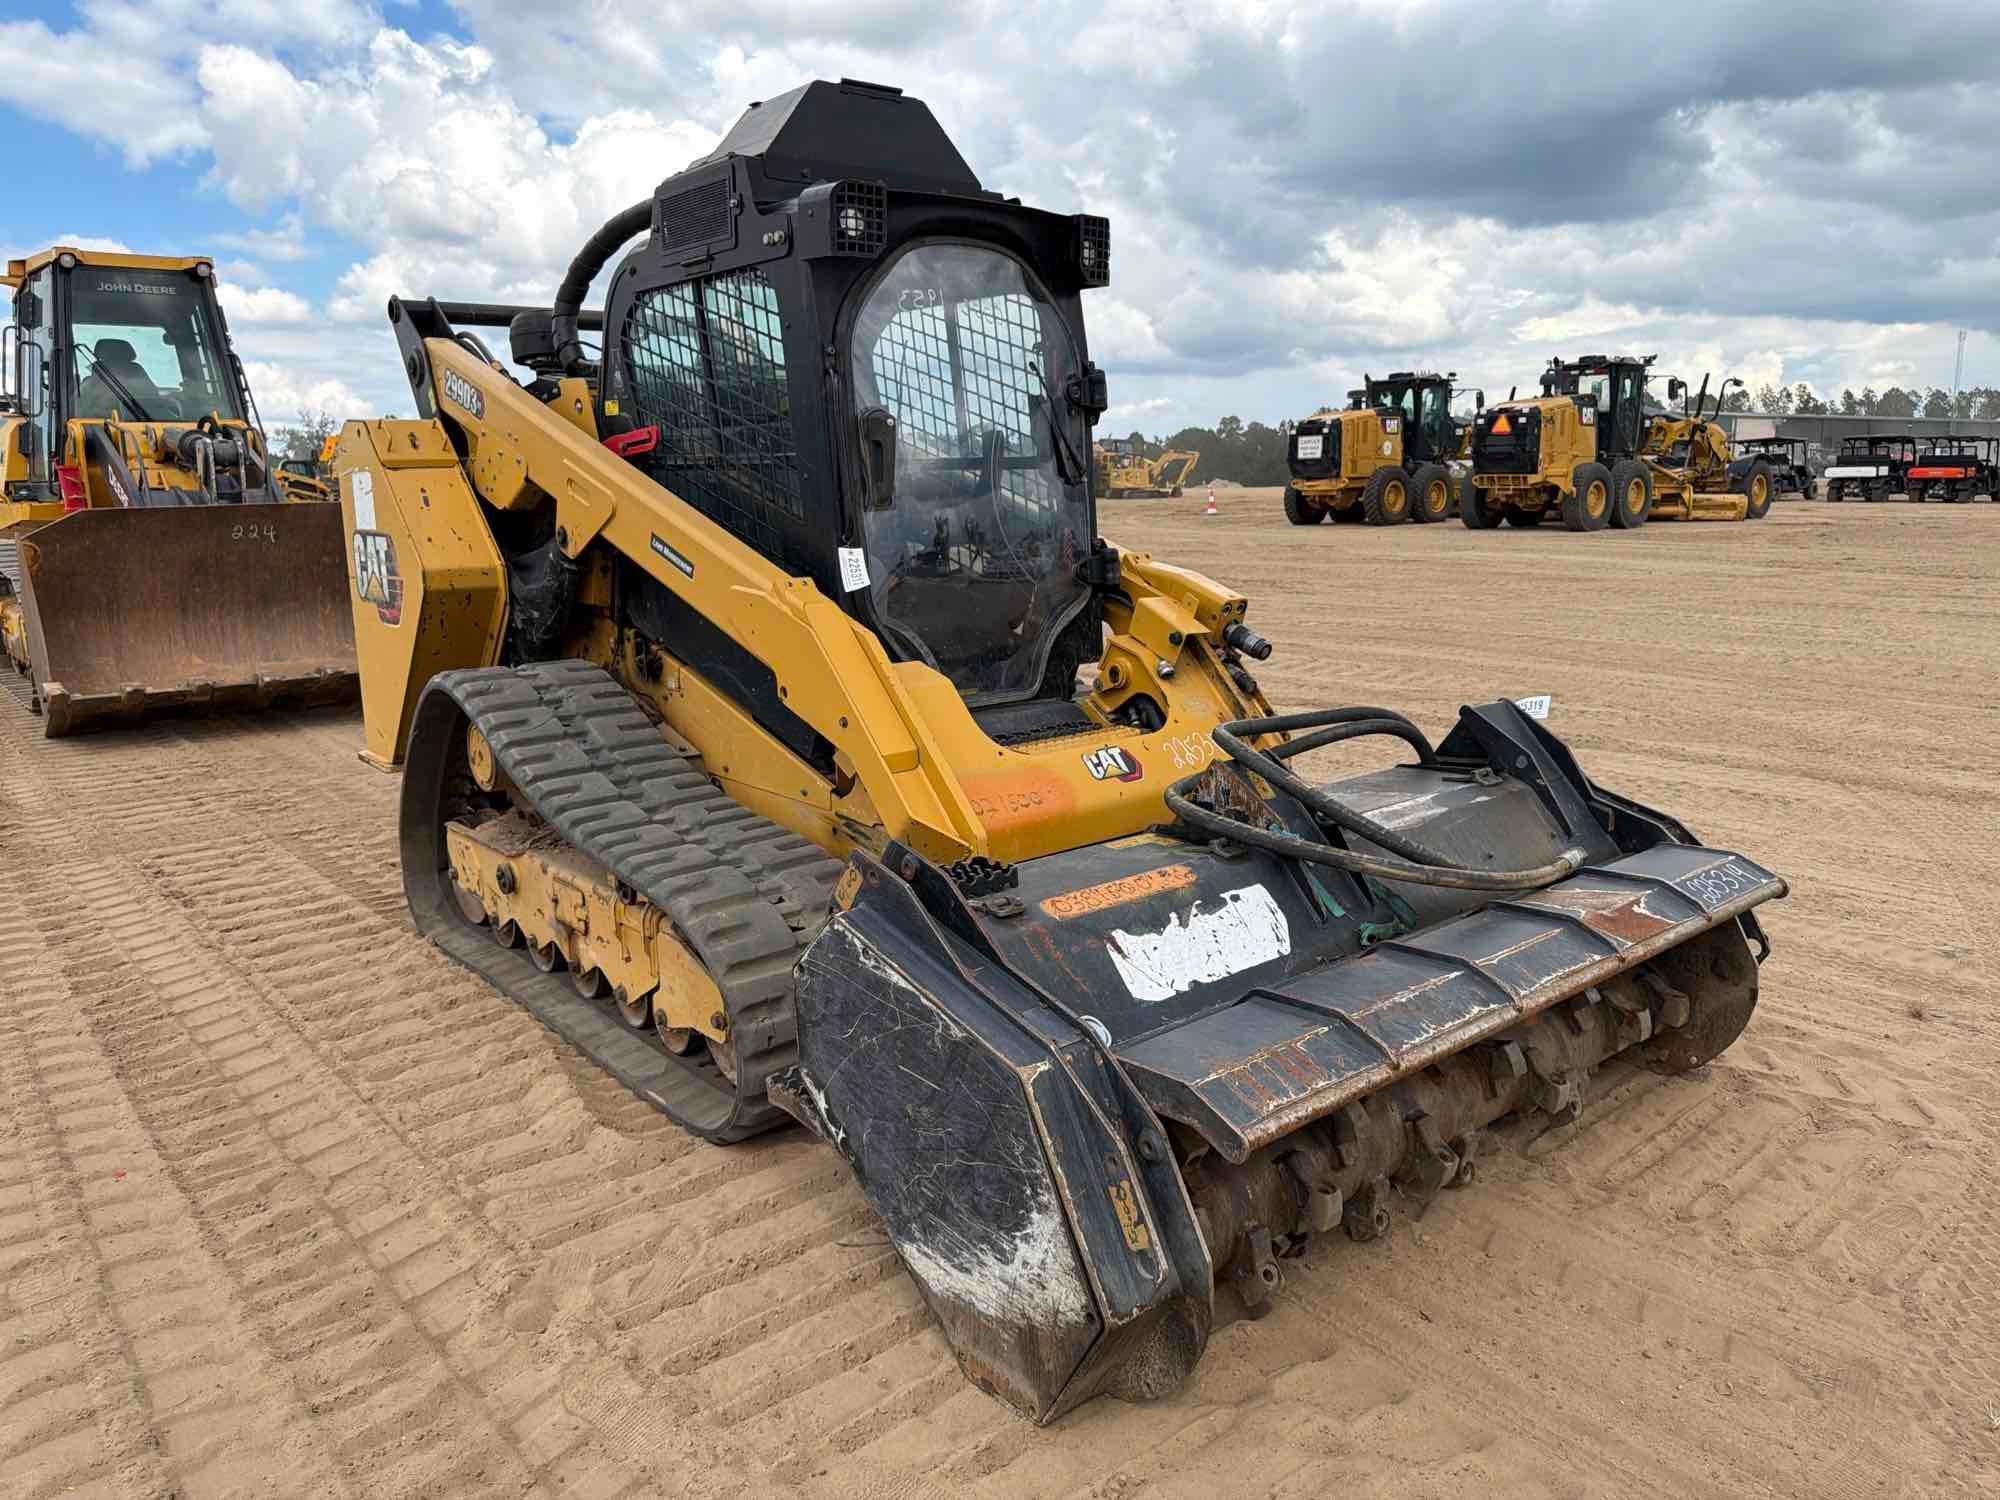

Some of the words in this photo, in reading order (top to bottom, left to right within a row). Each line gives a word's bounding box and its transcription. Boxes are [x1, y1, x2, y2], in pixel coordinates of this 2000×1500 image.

[96, 281, 133, 293] JOHN
[134, 283, 177, 295] DEERE
[1083, 747, 1129, 780] CAT
